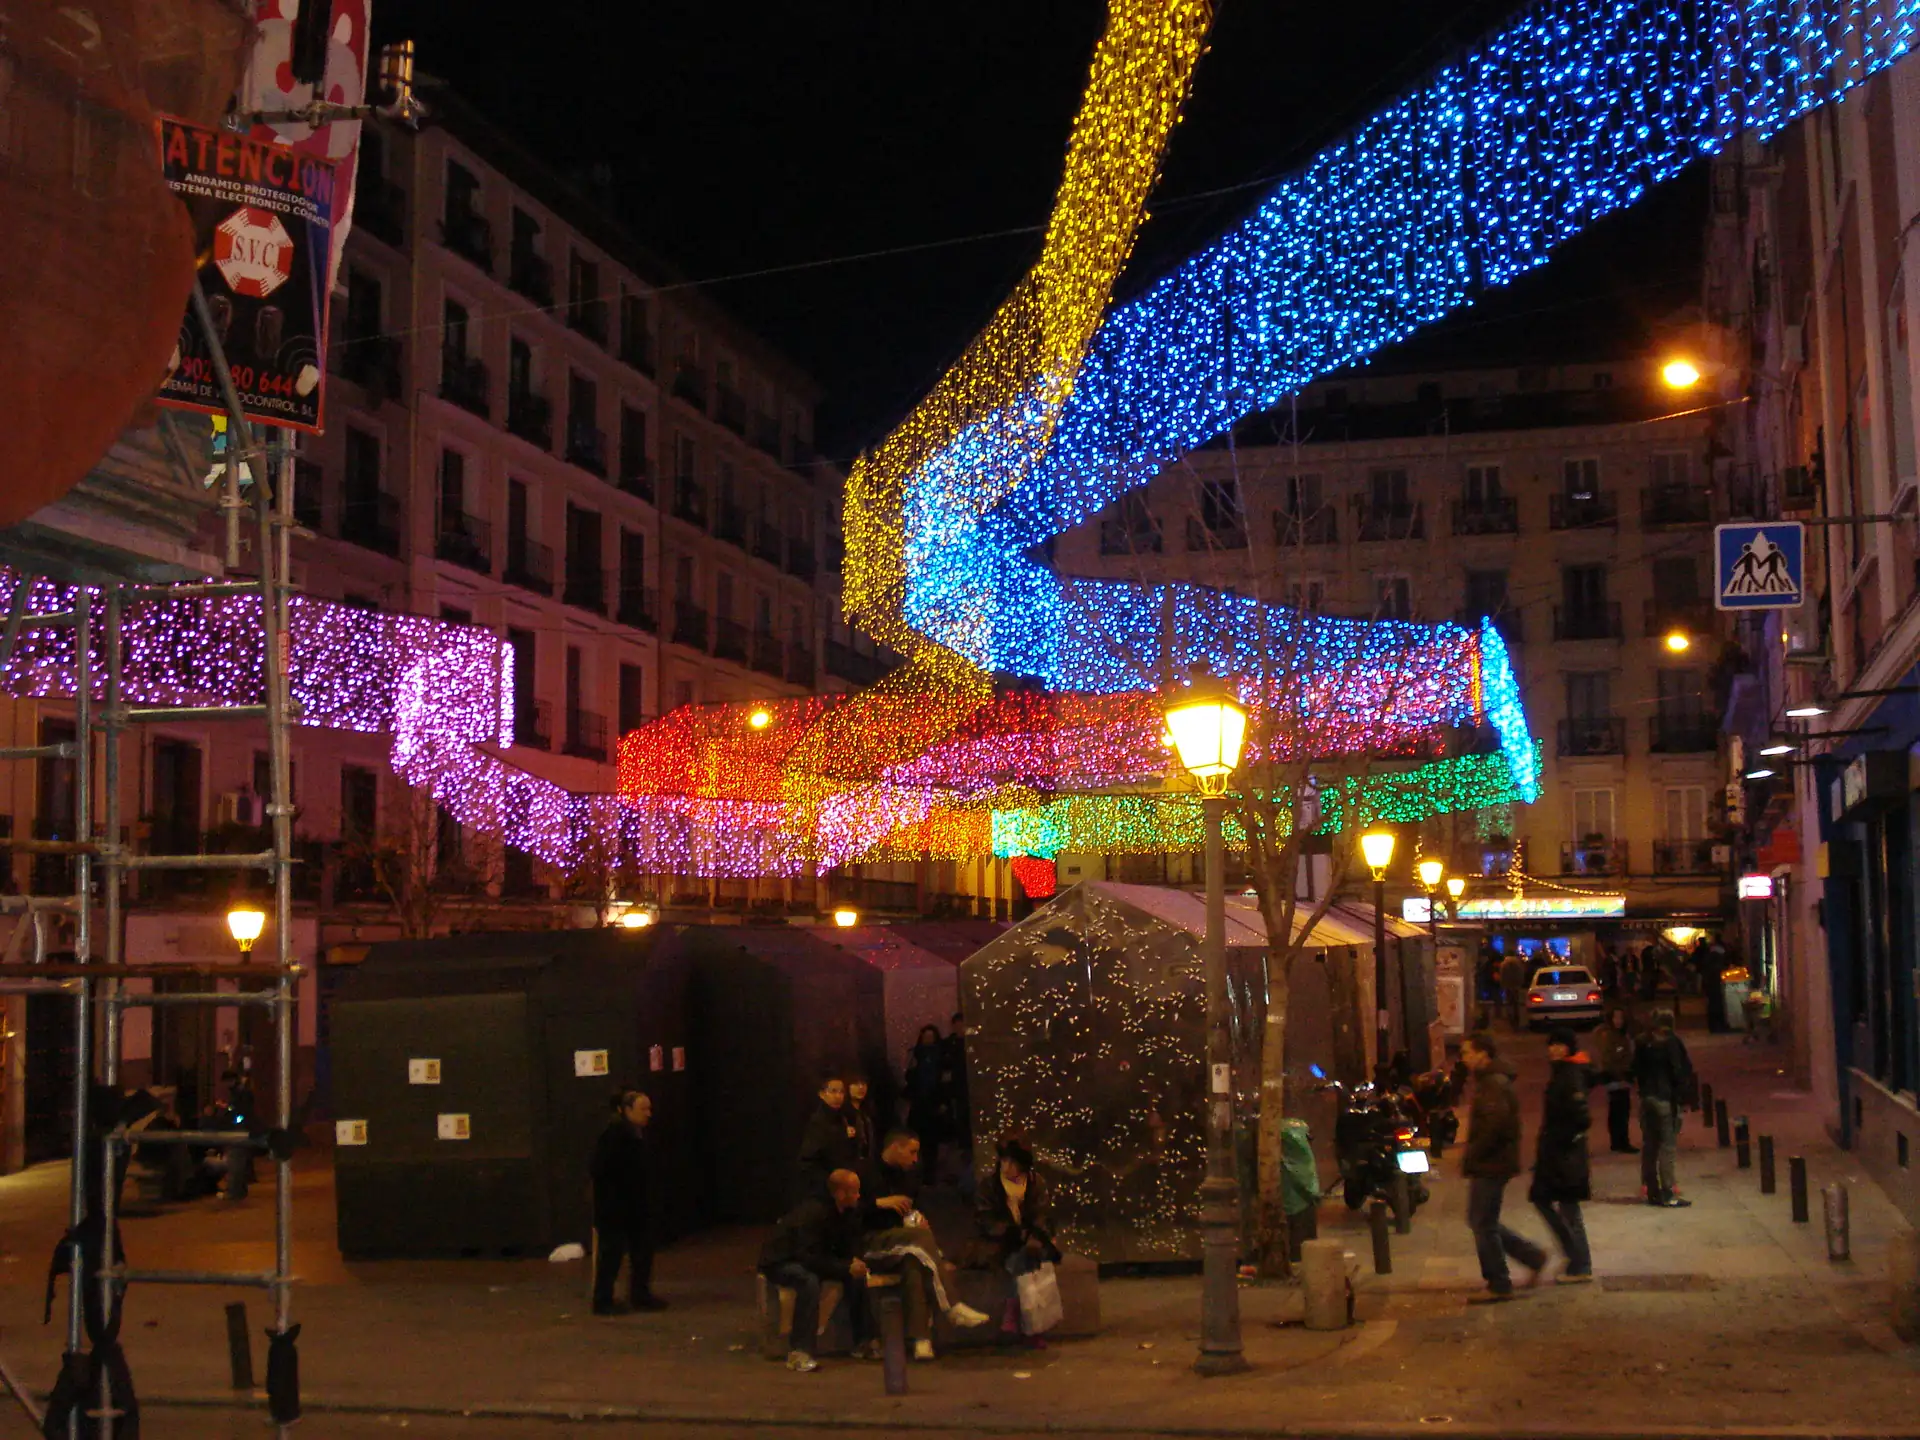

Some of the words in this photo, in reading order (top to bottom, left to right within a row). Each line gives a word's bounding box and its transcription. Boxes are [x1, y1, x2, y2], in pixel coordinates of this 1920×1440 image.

[167, 180, 213, 198] ISTEMA
[215, 189, 291, 214] ELECTRONICO
[184, 172, 241, 191] ANDAMIO
[244, 184, 305, 206] PROTEGIDO
[259, 371, 294, 398] 644
